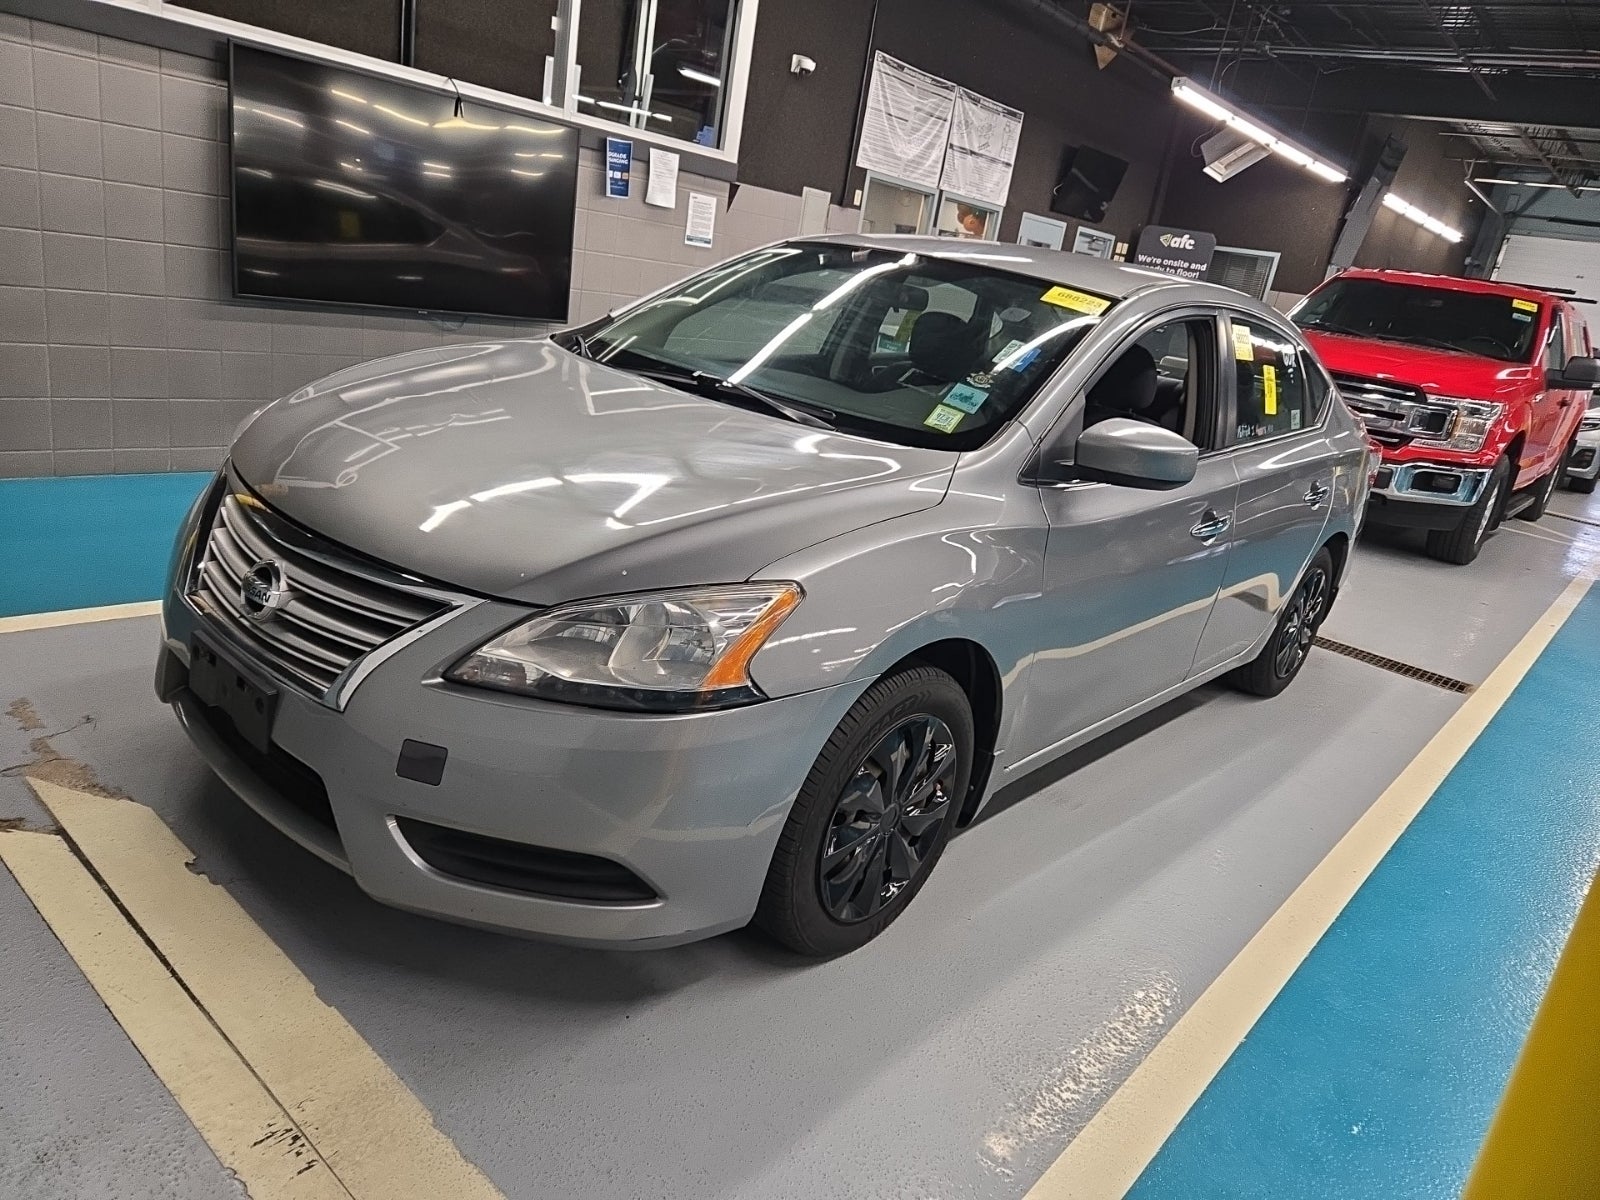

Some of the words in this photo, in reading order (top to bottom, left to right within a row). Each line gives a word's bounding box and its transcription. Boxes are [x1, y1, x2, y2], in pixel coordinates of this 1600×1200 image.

[1170, 234, 1195, 250] afc
[1138, 254, 1162, 264] We're
[1163, 259, 1190, 269] onsite
[1190, 263, 1207, 272] and
[1176, 268, 1200, 279] floor!
